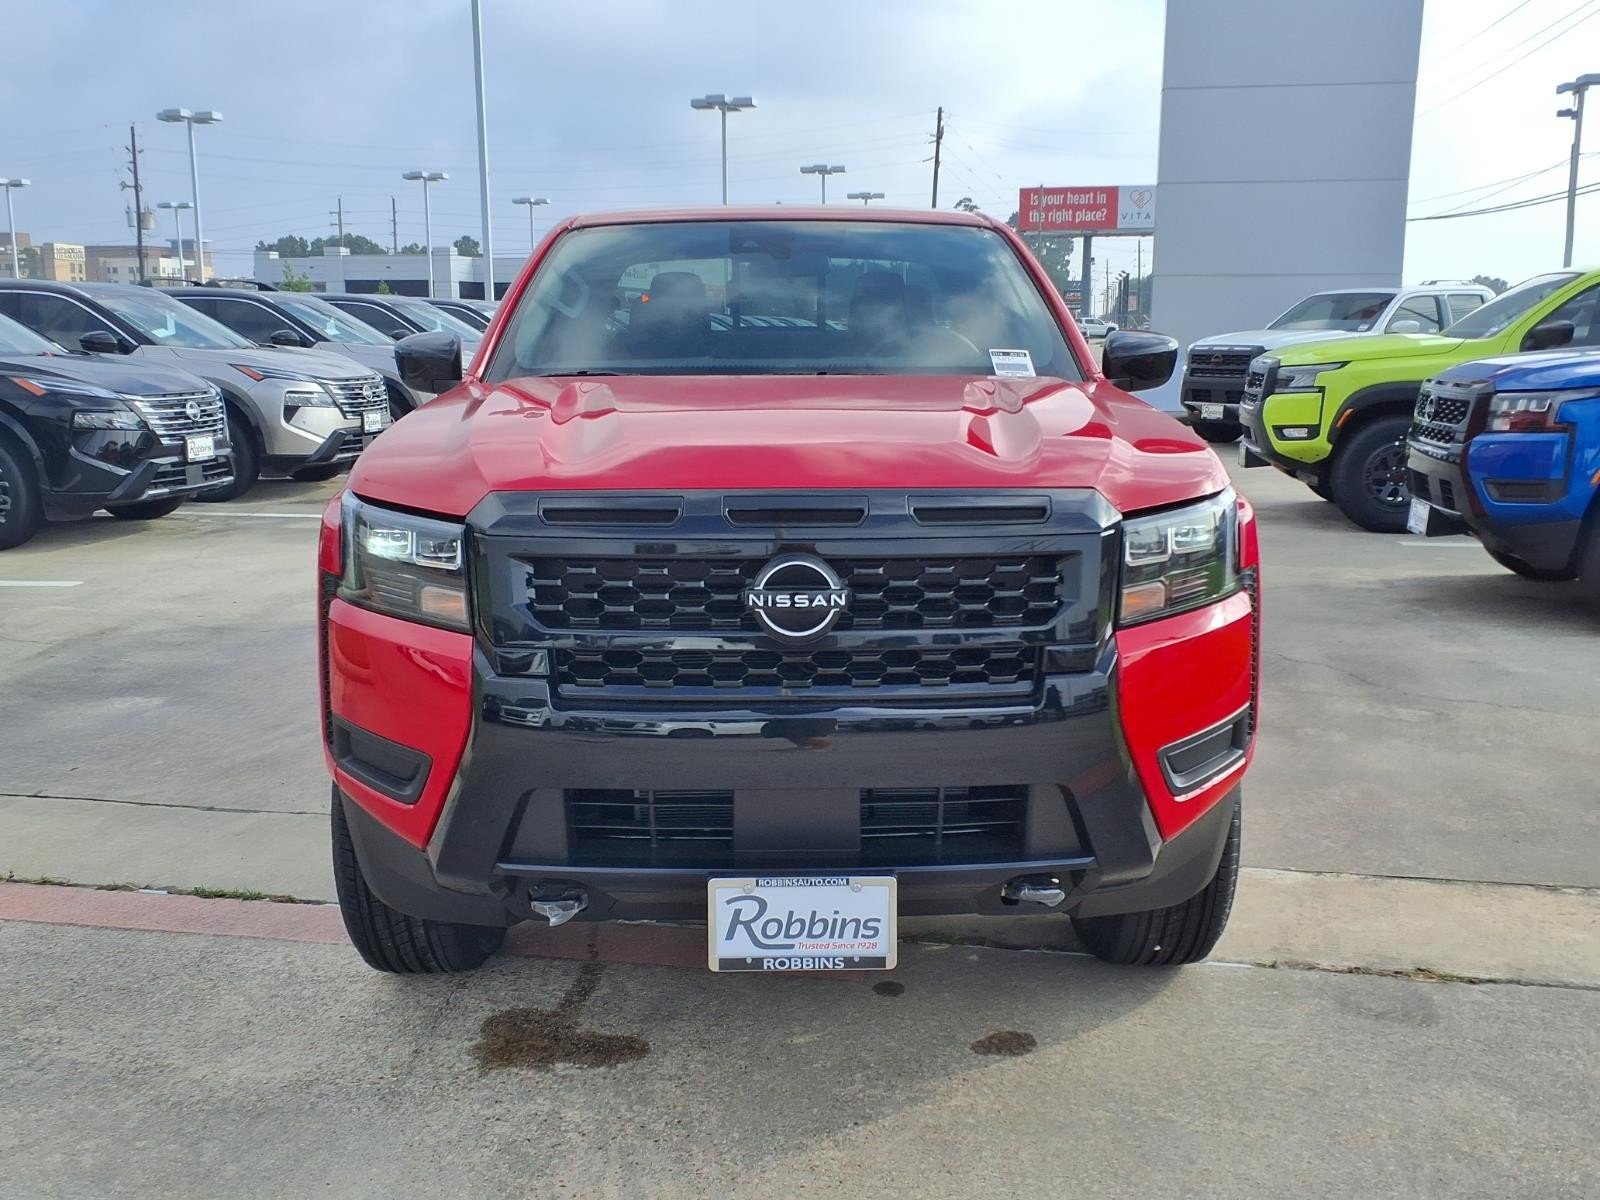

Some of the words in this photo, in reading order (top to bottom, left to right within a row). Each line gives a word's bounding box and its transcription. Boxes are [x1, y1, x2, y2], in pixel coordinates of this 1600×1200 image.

[1030, 193, 1039, 206] Is
[1041, 194, 1065, 208] your
[1067, 191, 1094, 205] heart
[1096, 191, 1107, 205] in
[1029, 209, 1046, 223] the
[1048, 208, 1073, 224] right
[1075, 208, 1107, 224] place?
[1121, 211, 1151, 220] VITA
[748, 593, 846, 607] NISSAN
[758, 878, 847, 887] ROBBINSAUTO.COM
[724, 894, 882, 950] Robbins
[797, 941, 830, 950] Trusted
[831, 941, 856, 950] Since
[857, 941, 878, 950] 1928
[763, 957, 845, 970] ROBBINS
